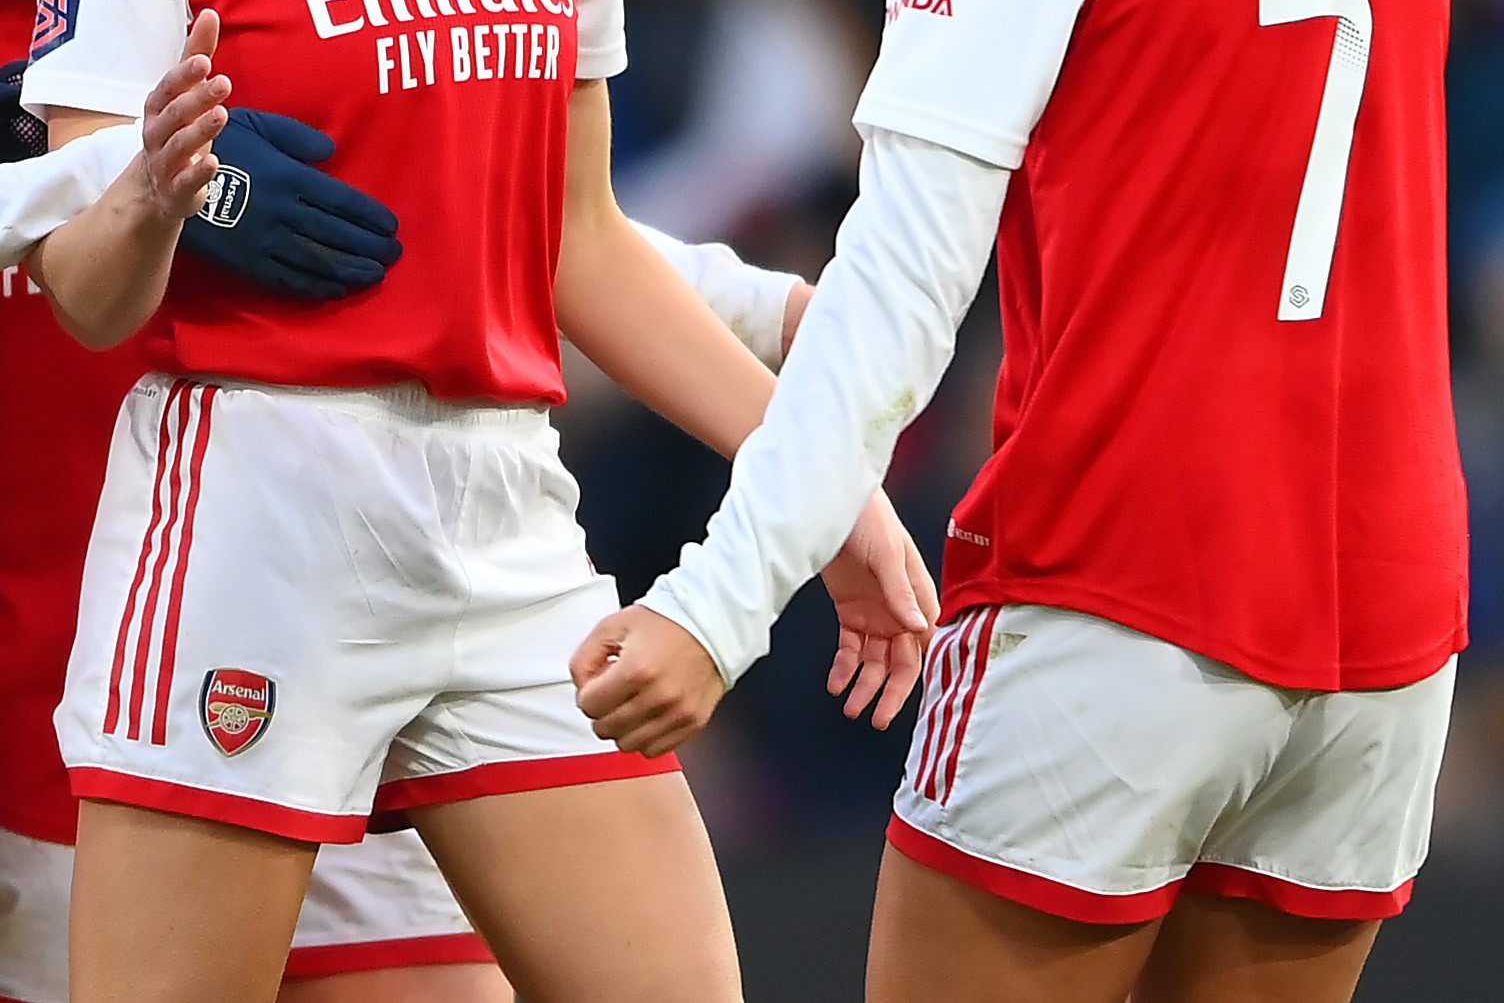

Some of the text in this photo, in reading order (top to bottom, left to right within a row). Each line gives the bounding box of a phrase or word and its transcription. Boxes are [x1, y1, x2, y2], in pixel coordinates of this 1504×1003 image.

[375, 24, 560, 94] FLY BETTER
[220, 176, 241, 219] Arsenal
[211, 679, 265, 701] Arsenal
